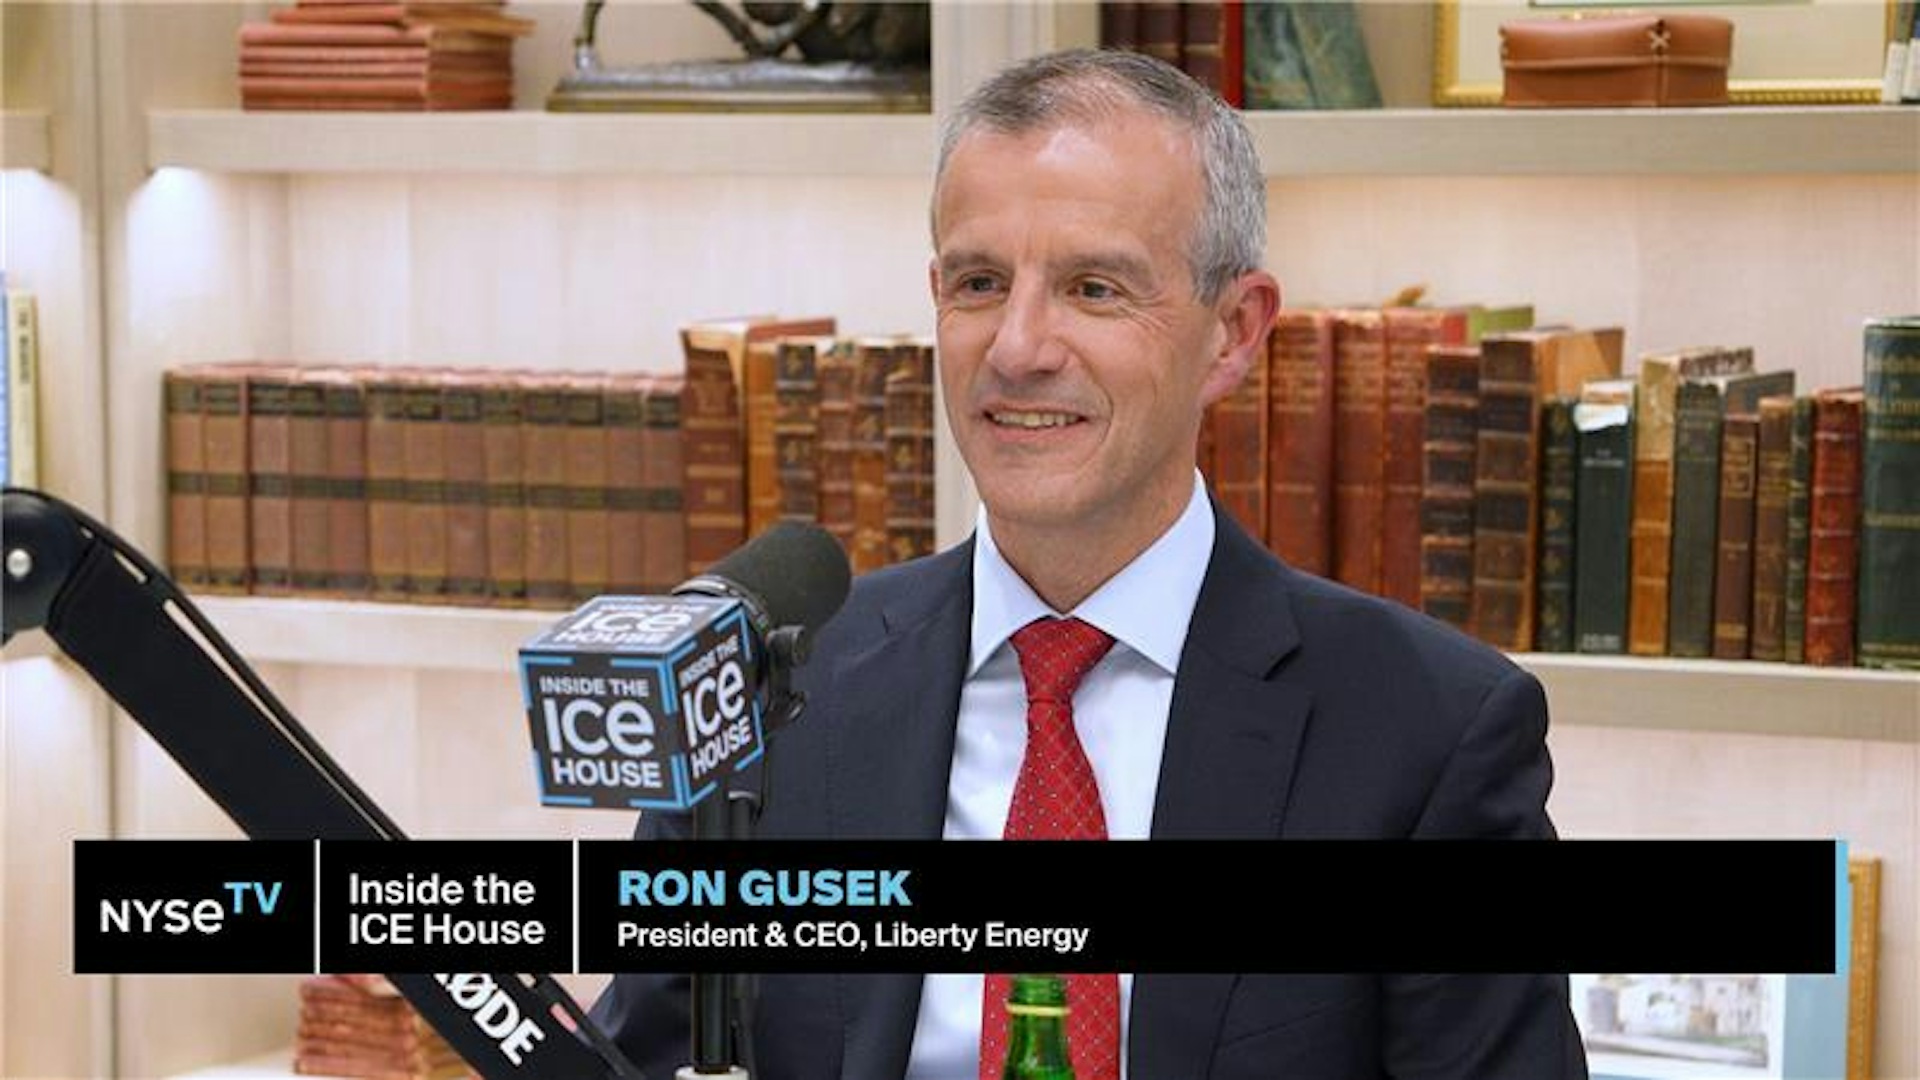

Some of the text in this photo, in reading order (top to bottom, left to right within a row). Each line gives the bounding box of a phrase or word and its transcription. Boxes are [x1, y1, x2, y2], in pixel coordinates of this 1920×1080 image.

[715, 635, 740, 661] THE
[540, 676, 650, 697] INSIDE THE
[690, 716, 753, 779] HOUSE
[553, 759, 663, 788] HOUSE
[434, 973, 545, 1066] ØDE
